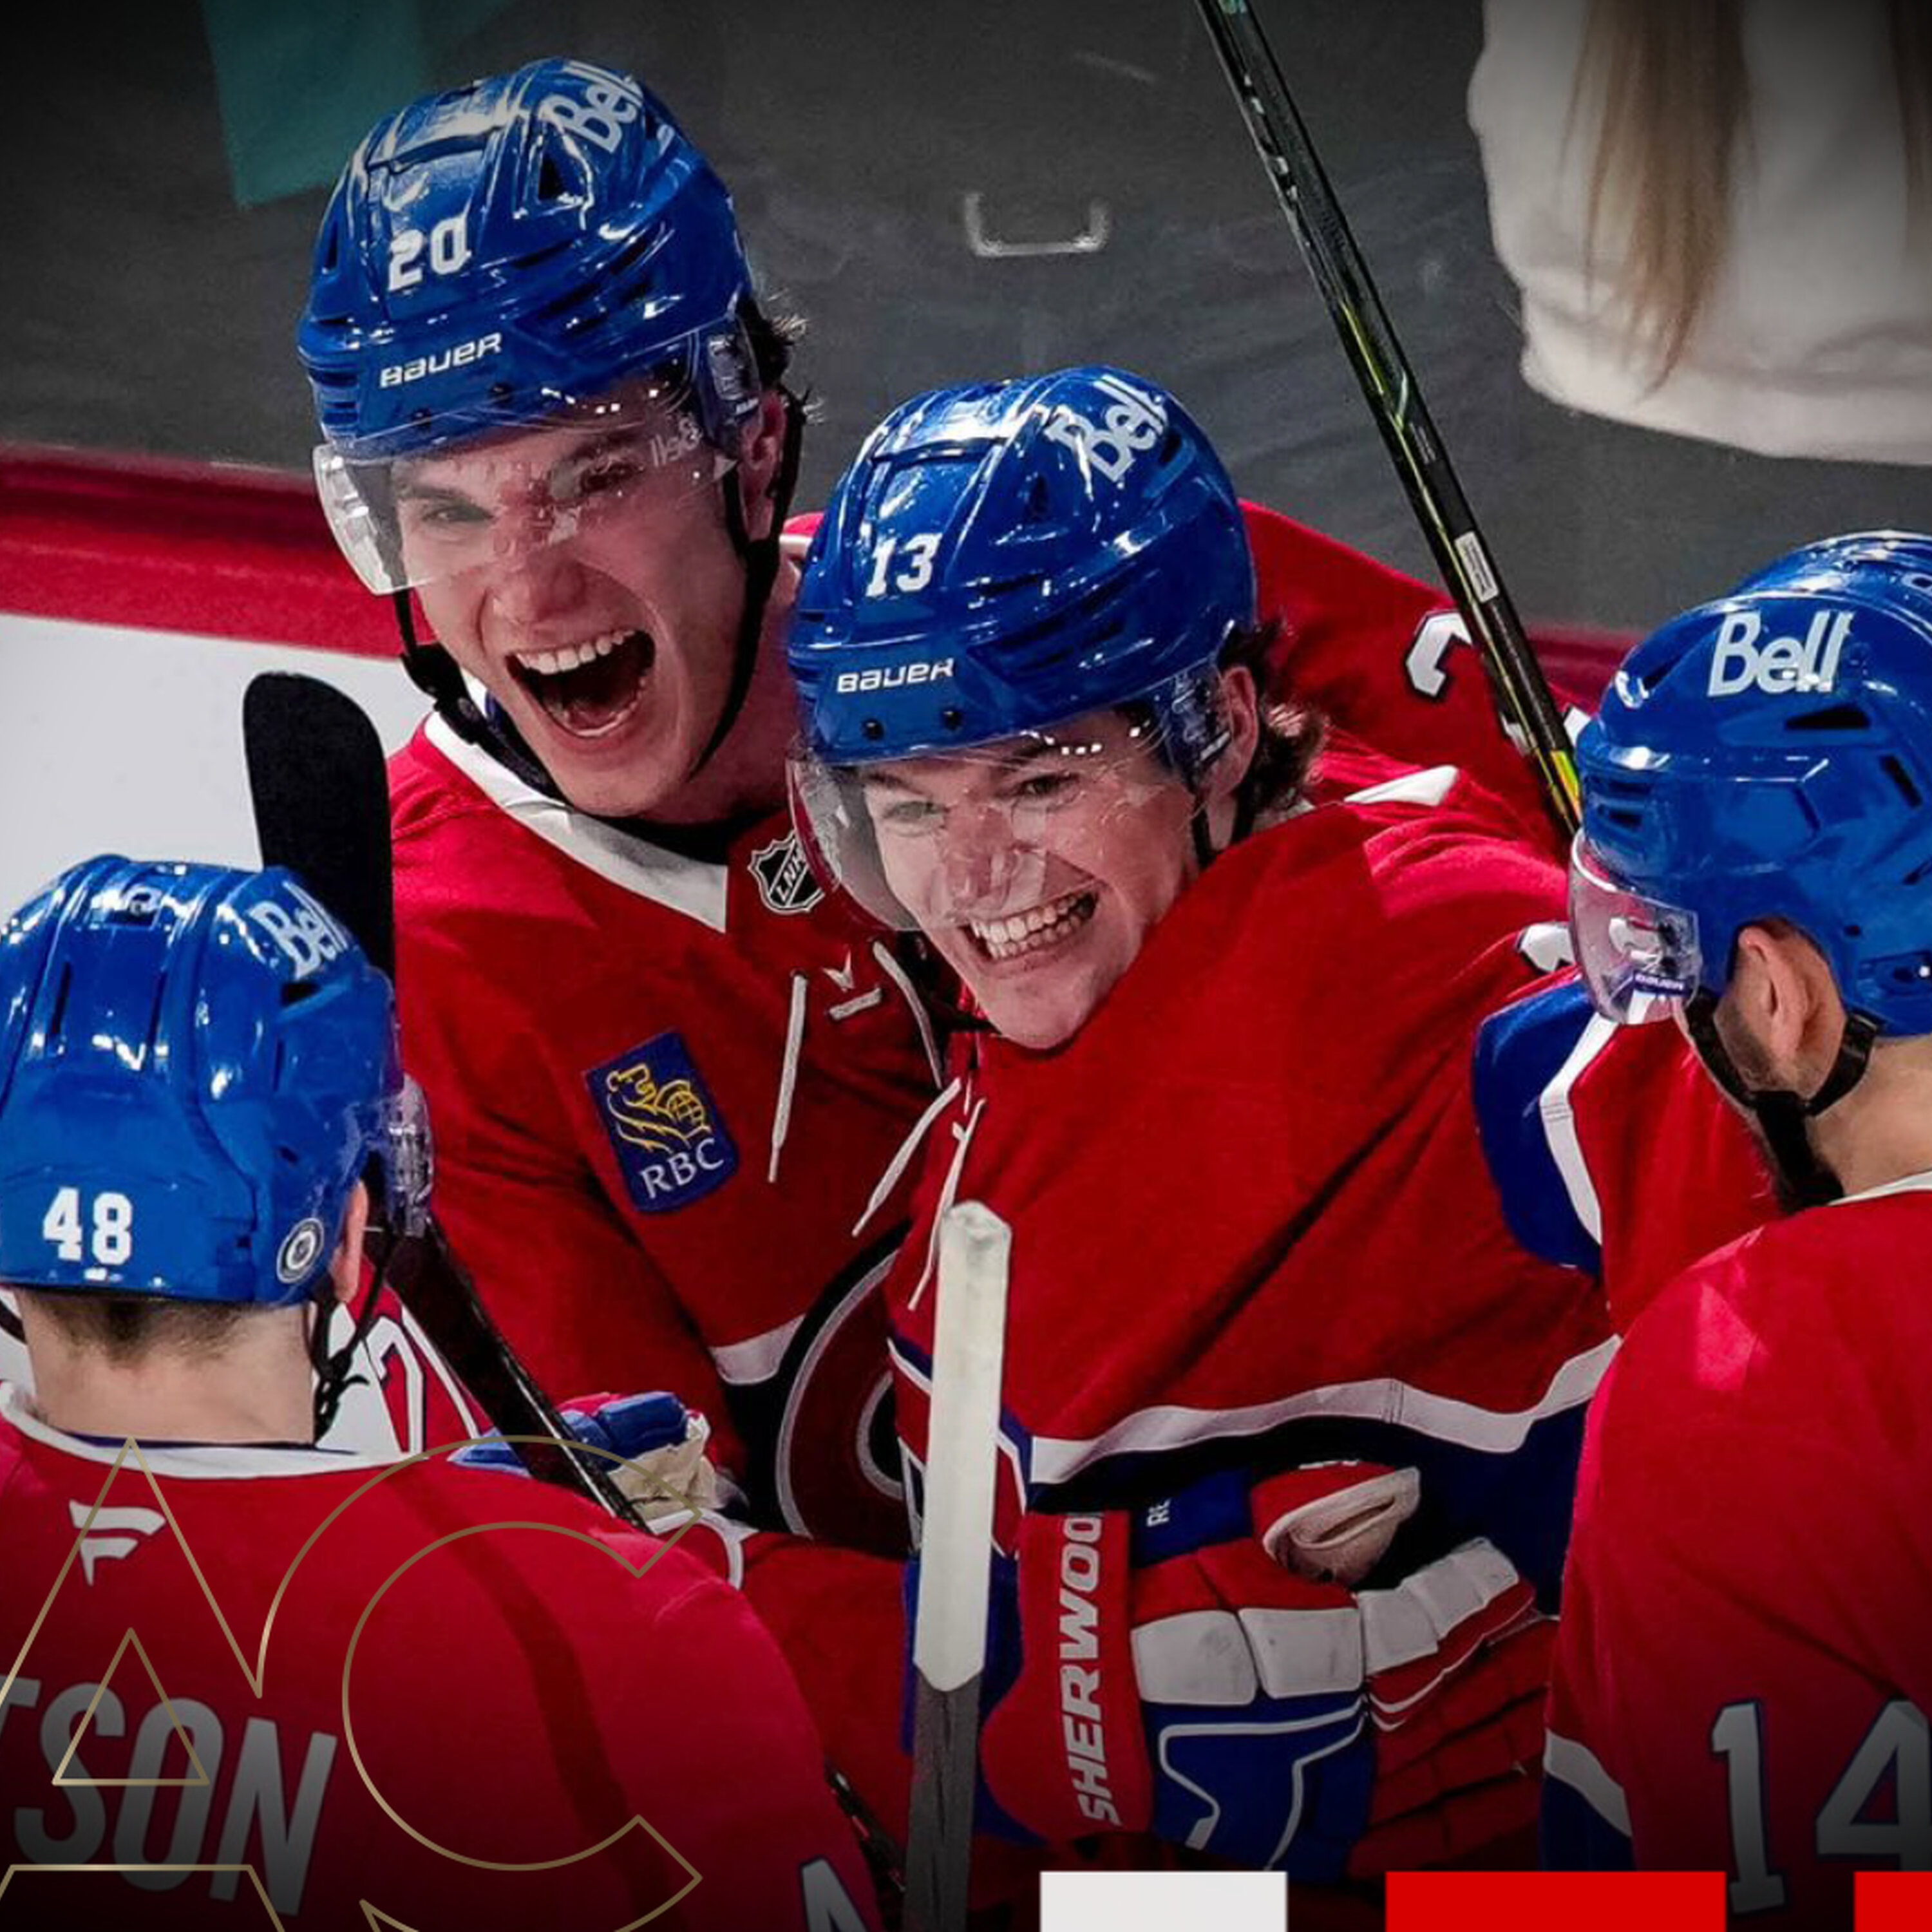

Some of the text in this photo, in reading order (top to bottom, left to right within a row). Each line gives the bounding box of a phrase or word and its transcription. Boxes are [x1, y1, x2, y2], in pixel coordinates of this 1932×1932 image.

[538, 61, 644, 153] Bell
[388, 216, 471, 292] 20
[379, 332, 503, 388] BAUER
[1043, 374, 1168, 482] Bell
[865, 532, 943, 598] 13
[836, 658, 954, 694] BAUER
[1707, 611, 1855, 697] Bell
[249, 880, 348, 981] Bell
[639, 1138, 724, 1199] RBC
[42, 1187, 133, 1265] 48
[1059, 1511, 1122, 1827] SHERWOO
[1712, 1700, 1932, 1916] 14
